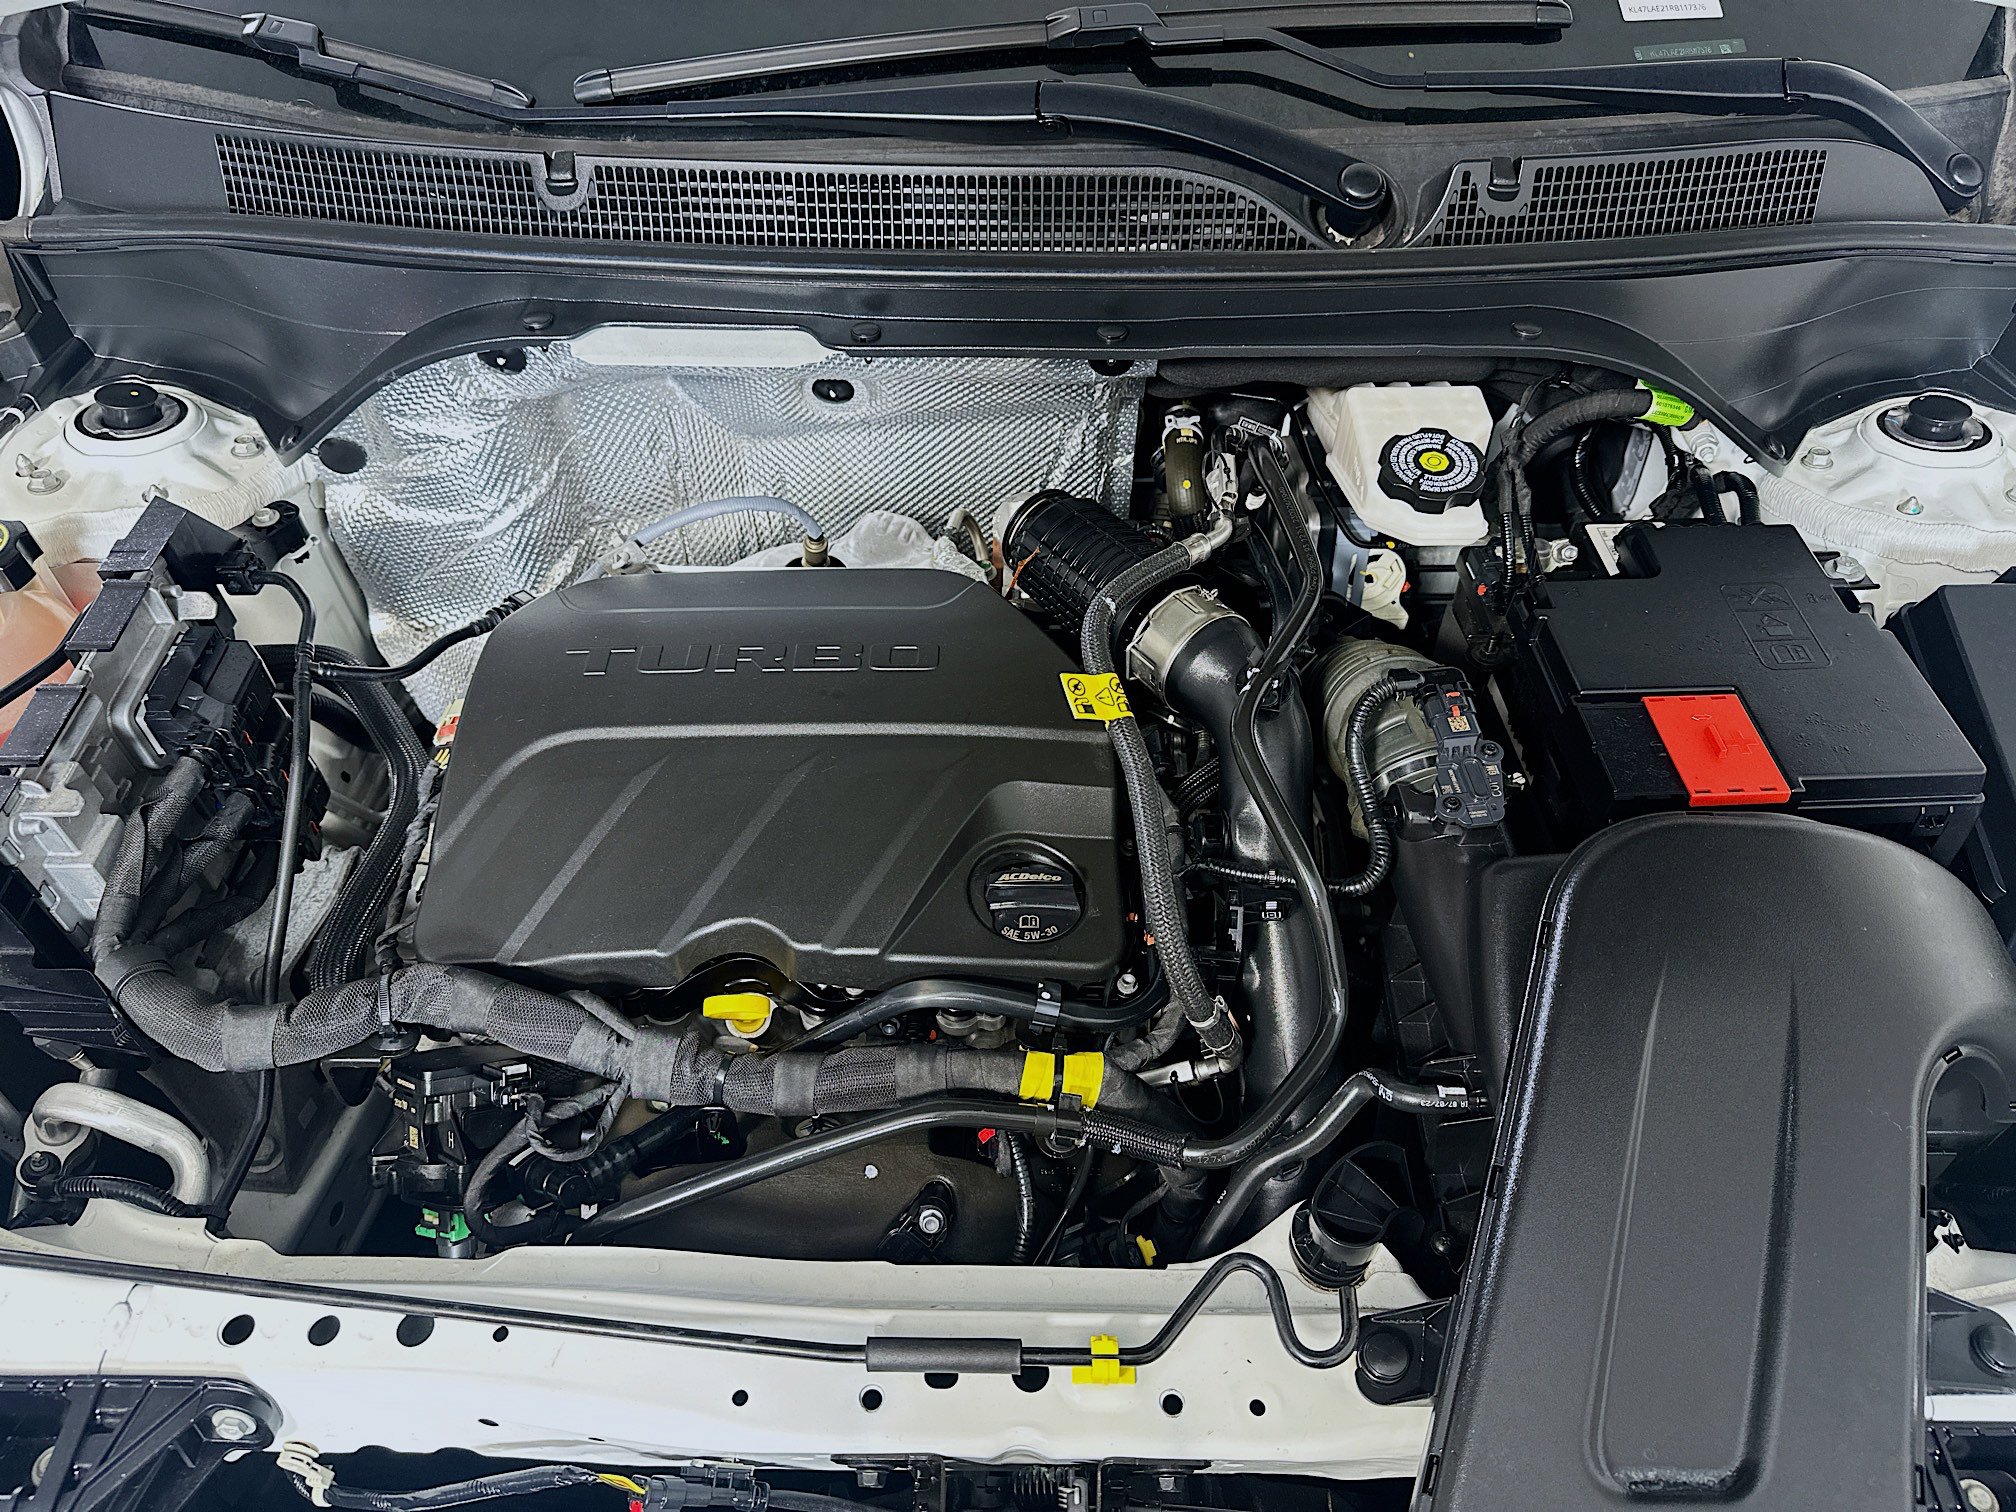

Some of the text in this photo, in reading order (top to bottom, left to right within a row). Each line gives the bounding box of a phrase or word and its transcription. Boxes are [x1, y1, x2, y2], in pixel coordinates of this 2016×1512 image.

[566, 644, 941, 676] TURBO
[997, 872, 1062, 882] ACDelco
[1001, 925, 1059, 940] SAE 5W-30
